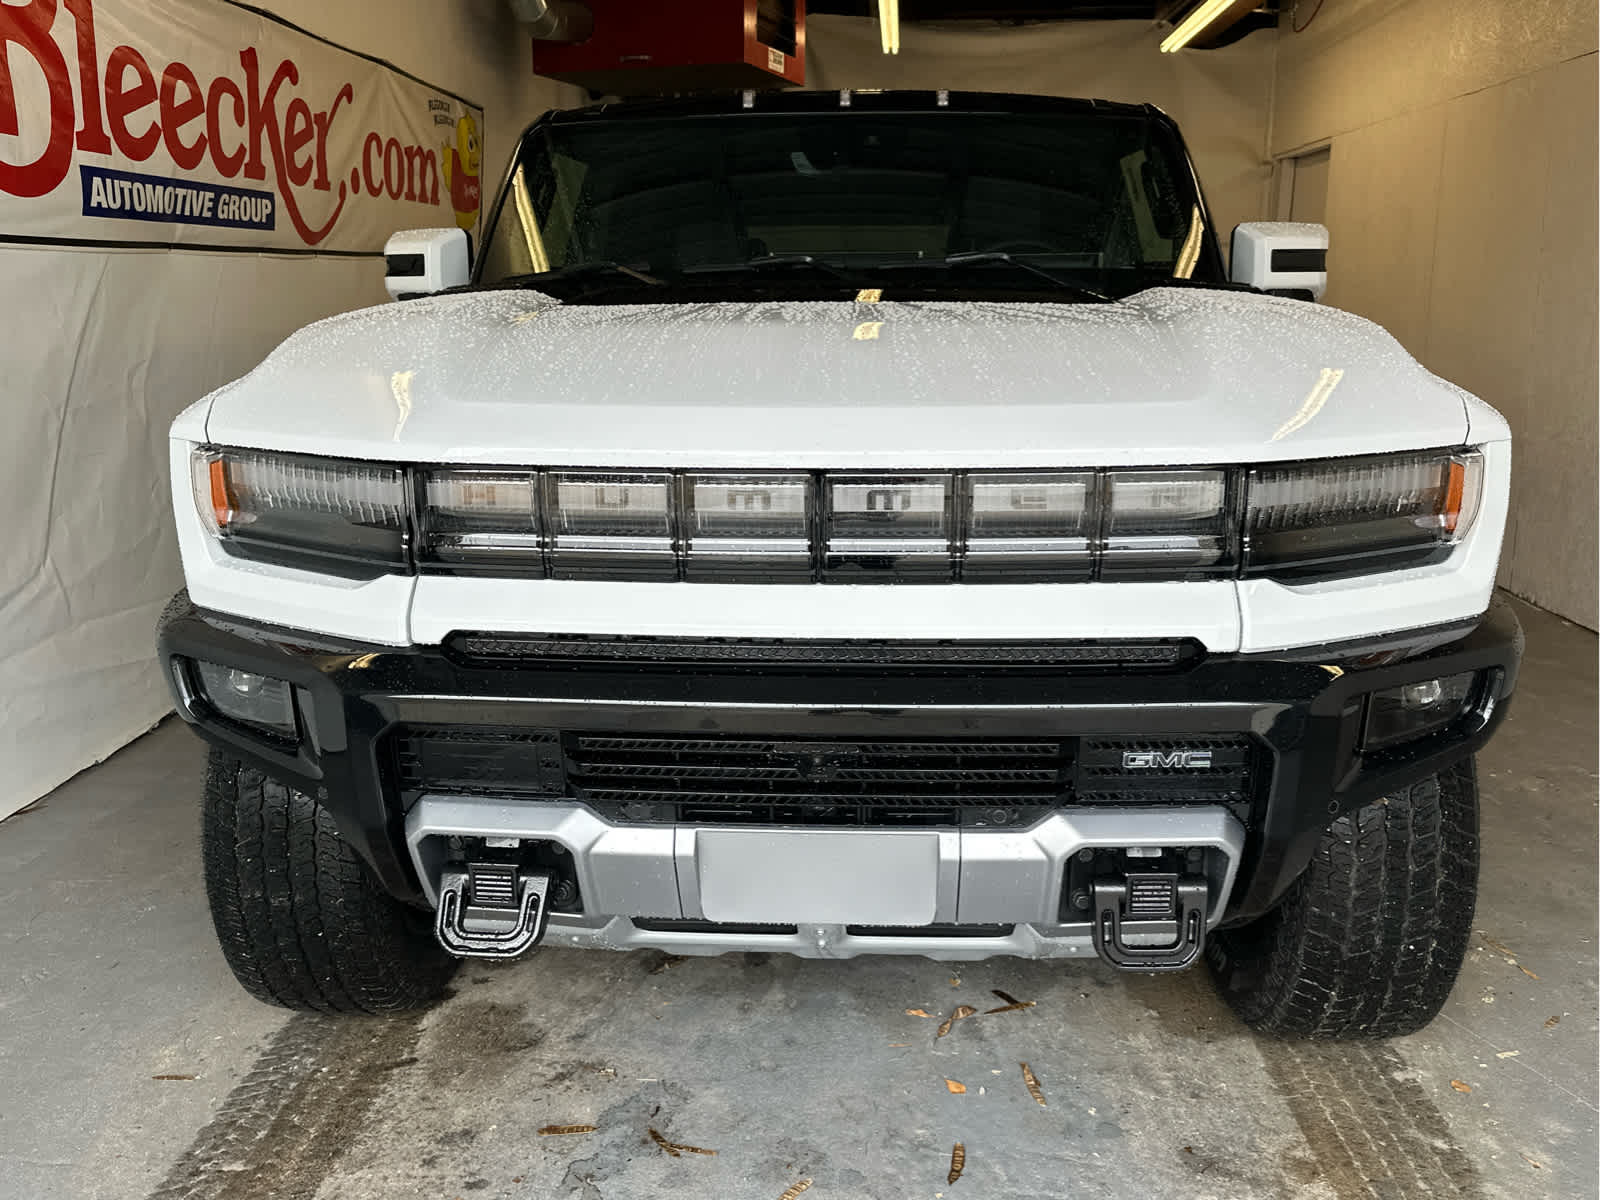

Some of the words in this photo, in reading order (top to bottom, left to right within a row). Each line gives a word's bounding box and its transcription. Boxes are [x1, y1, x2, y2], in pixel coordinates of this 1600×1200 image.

[90, 176, 215, 218] AUTOMOTIVE
[217, 193, 272, 223] GROUP
[1122, 751, 1212, 768] GMC
